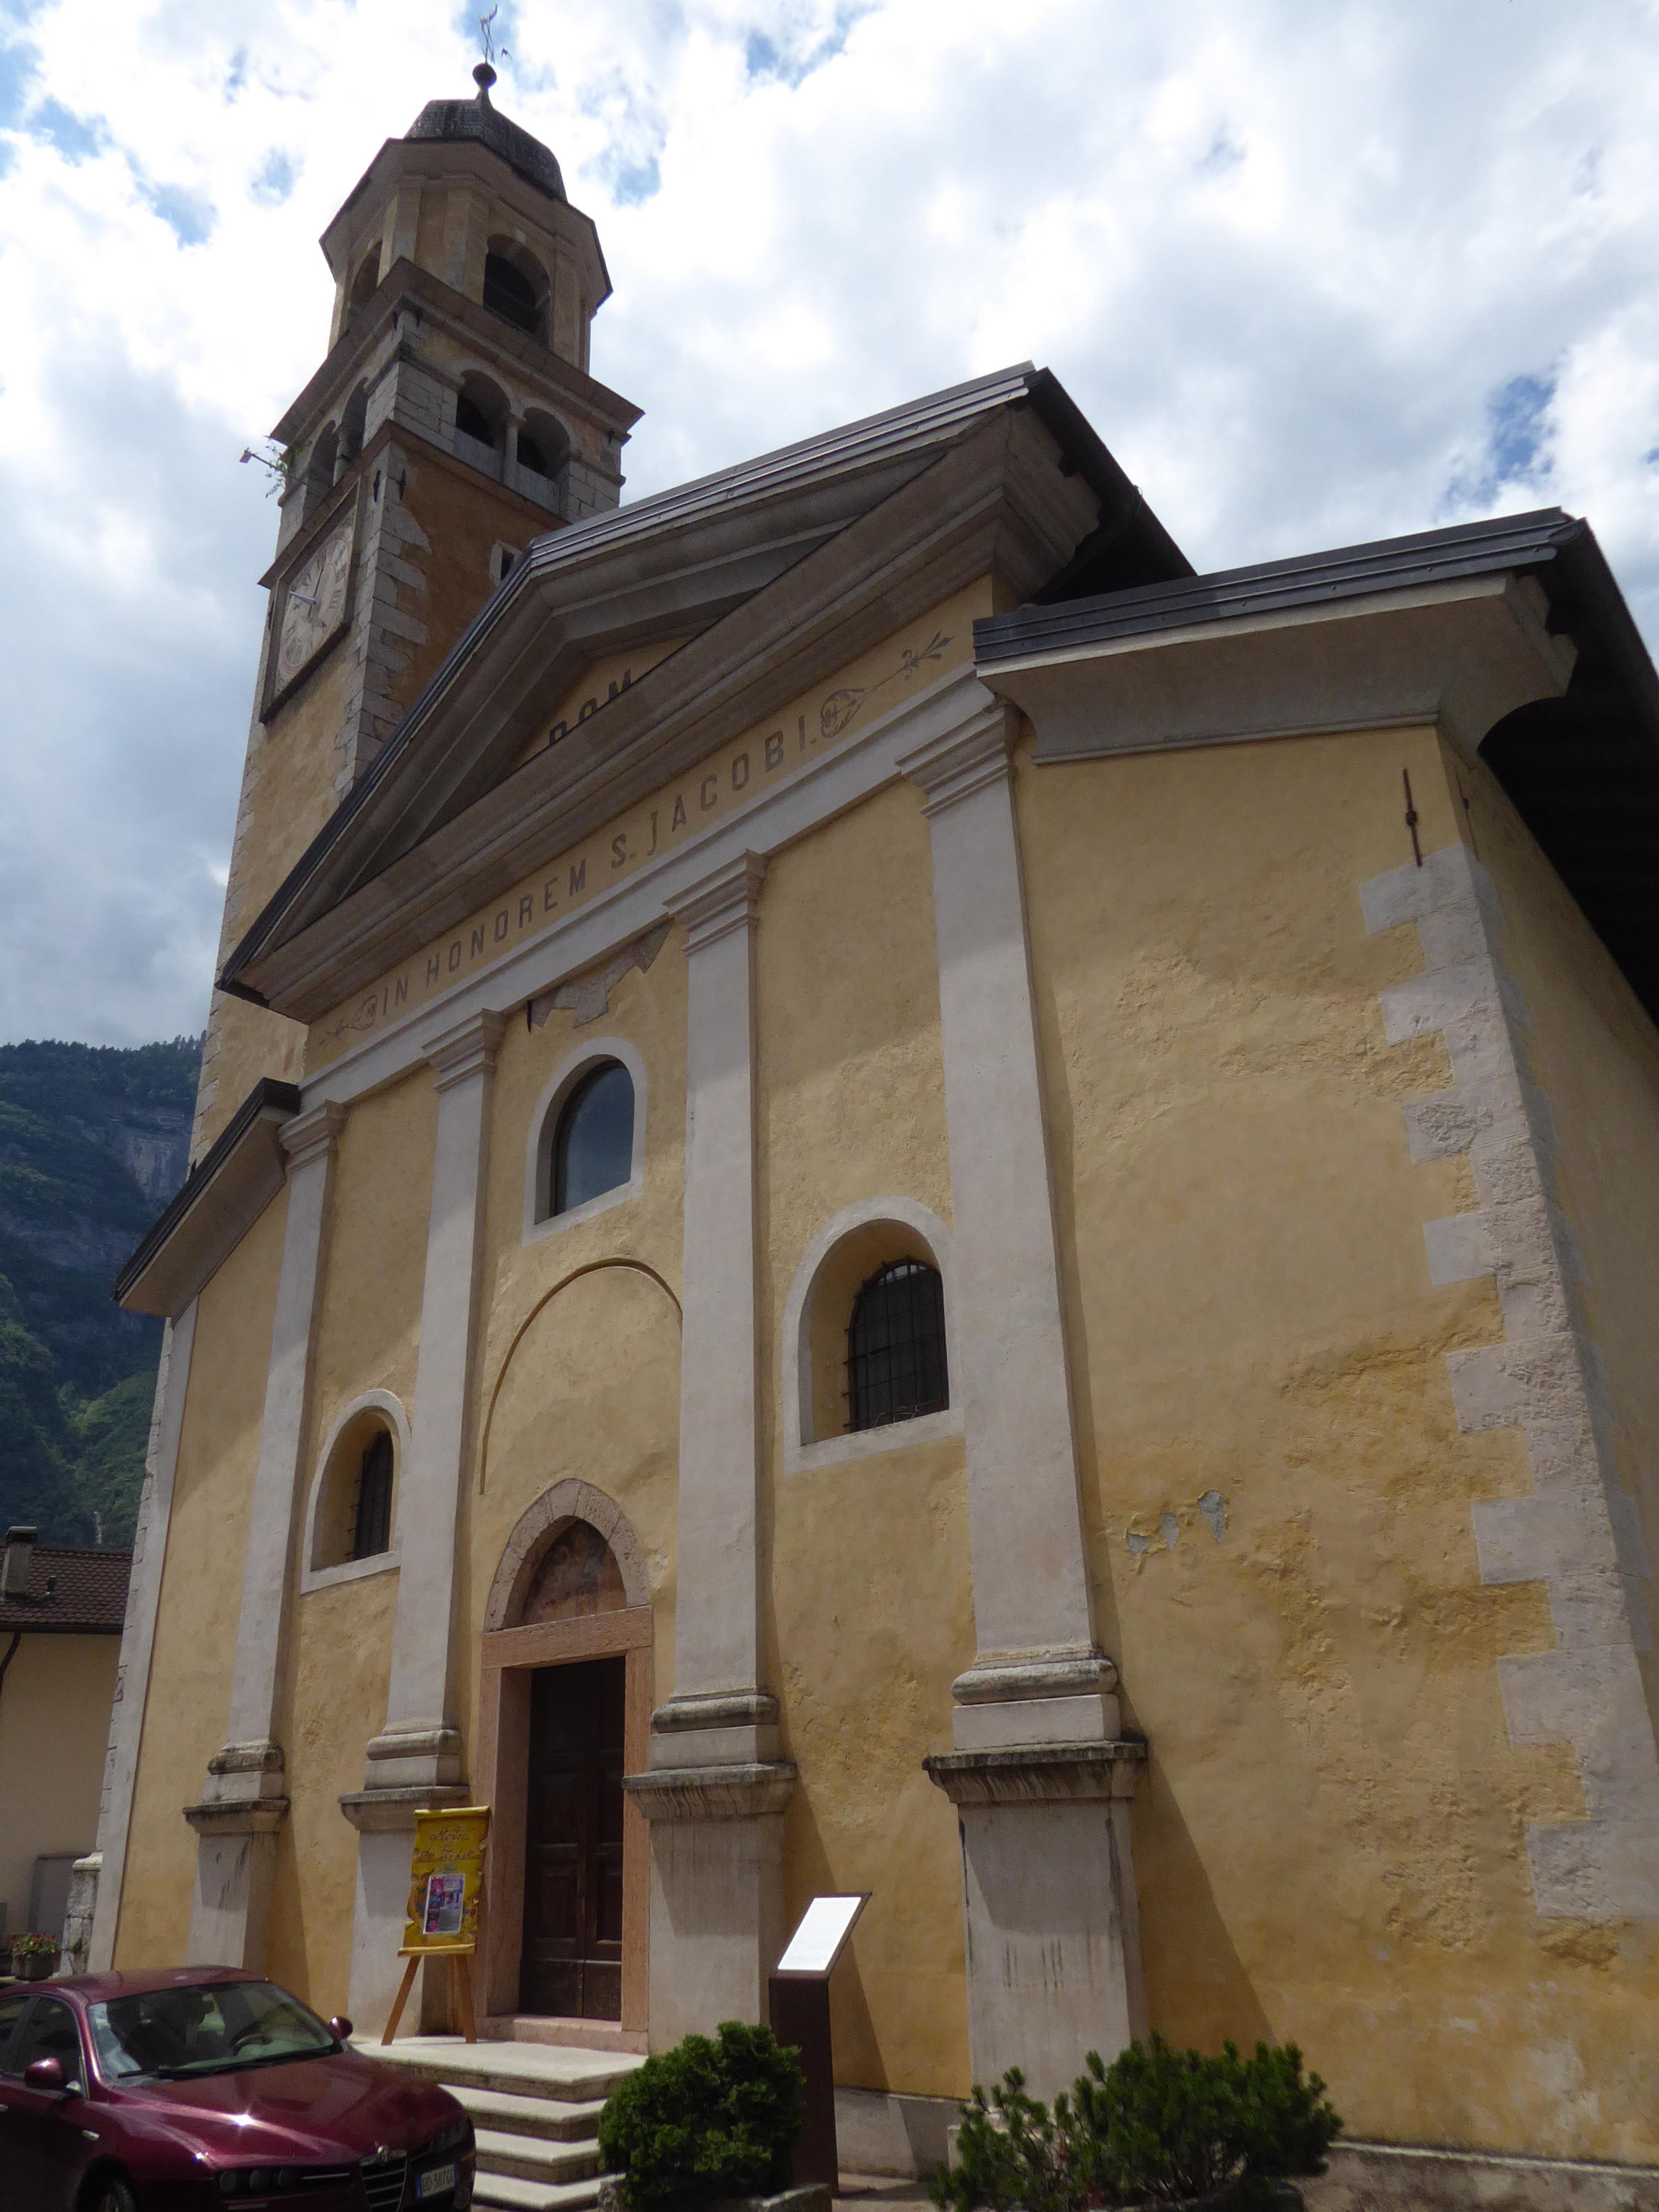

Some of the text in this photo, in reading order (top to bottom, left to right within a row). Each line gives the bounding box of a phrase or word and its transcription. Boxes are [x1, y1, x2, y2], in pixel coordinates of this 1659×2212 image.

[383, 973, 409, 1016] IN
[426, 858, 586, 989] HONOREM
[611, 833, 635, 869] S.
